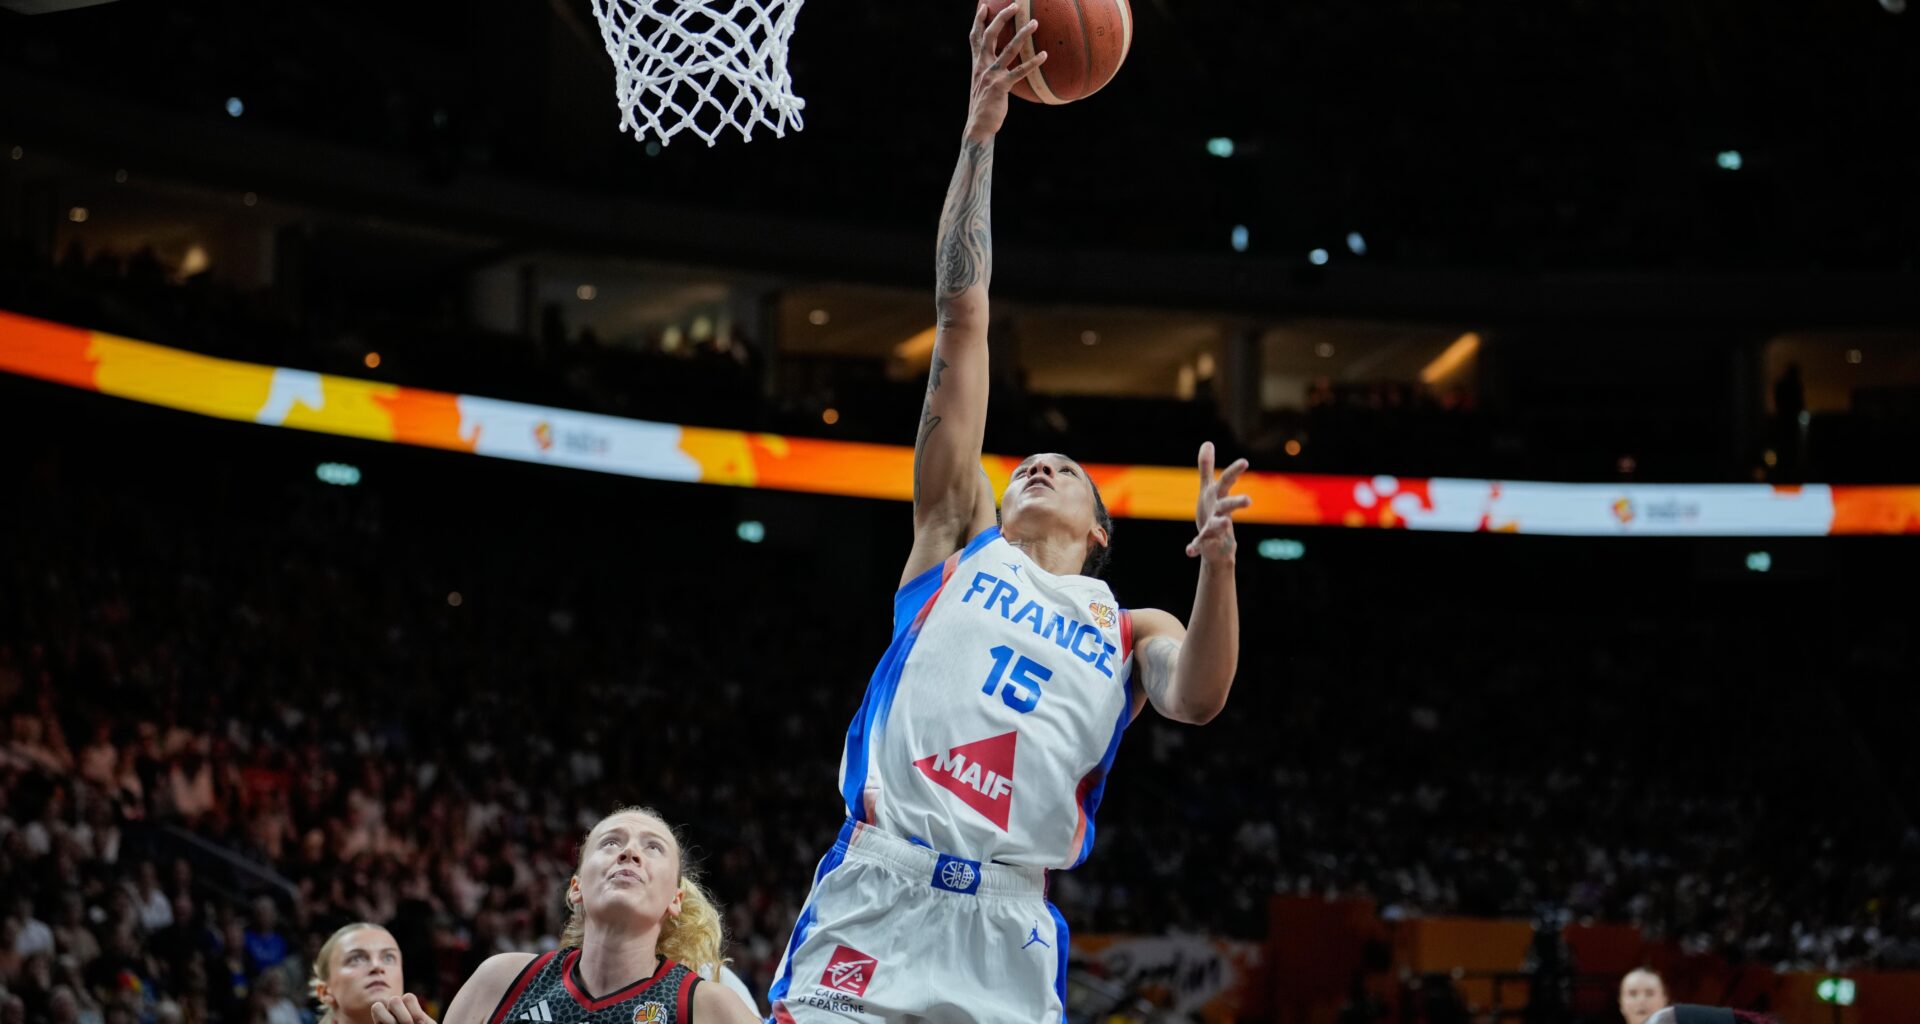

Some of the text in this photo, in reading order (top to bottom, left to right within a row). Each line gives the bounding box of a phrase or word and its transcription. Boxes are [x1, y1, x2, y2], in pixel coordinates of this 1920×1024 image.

[961, 571, 1117, 679] FRANCE
[981, 645, 1053, 714] 15
[932, 751, 1014, 801] MAIF
[798, 996, 865, 1014] DEPARGNE
[815, 988, 852, 1002] CAISS
